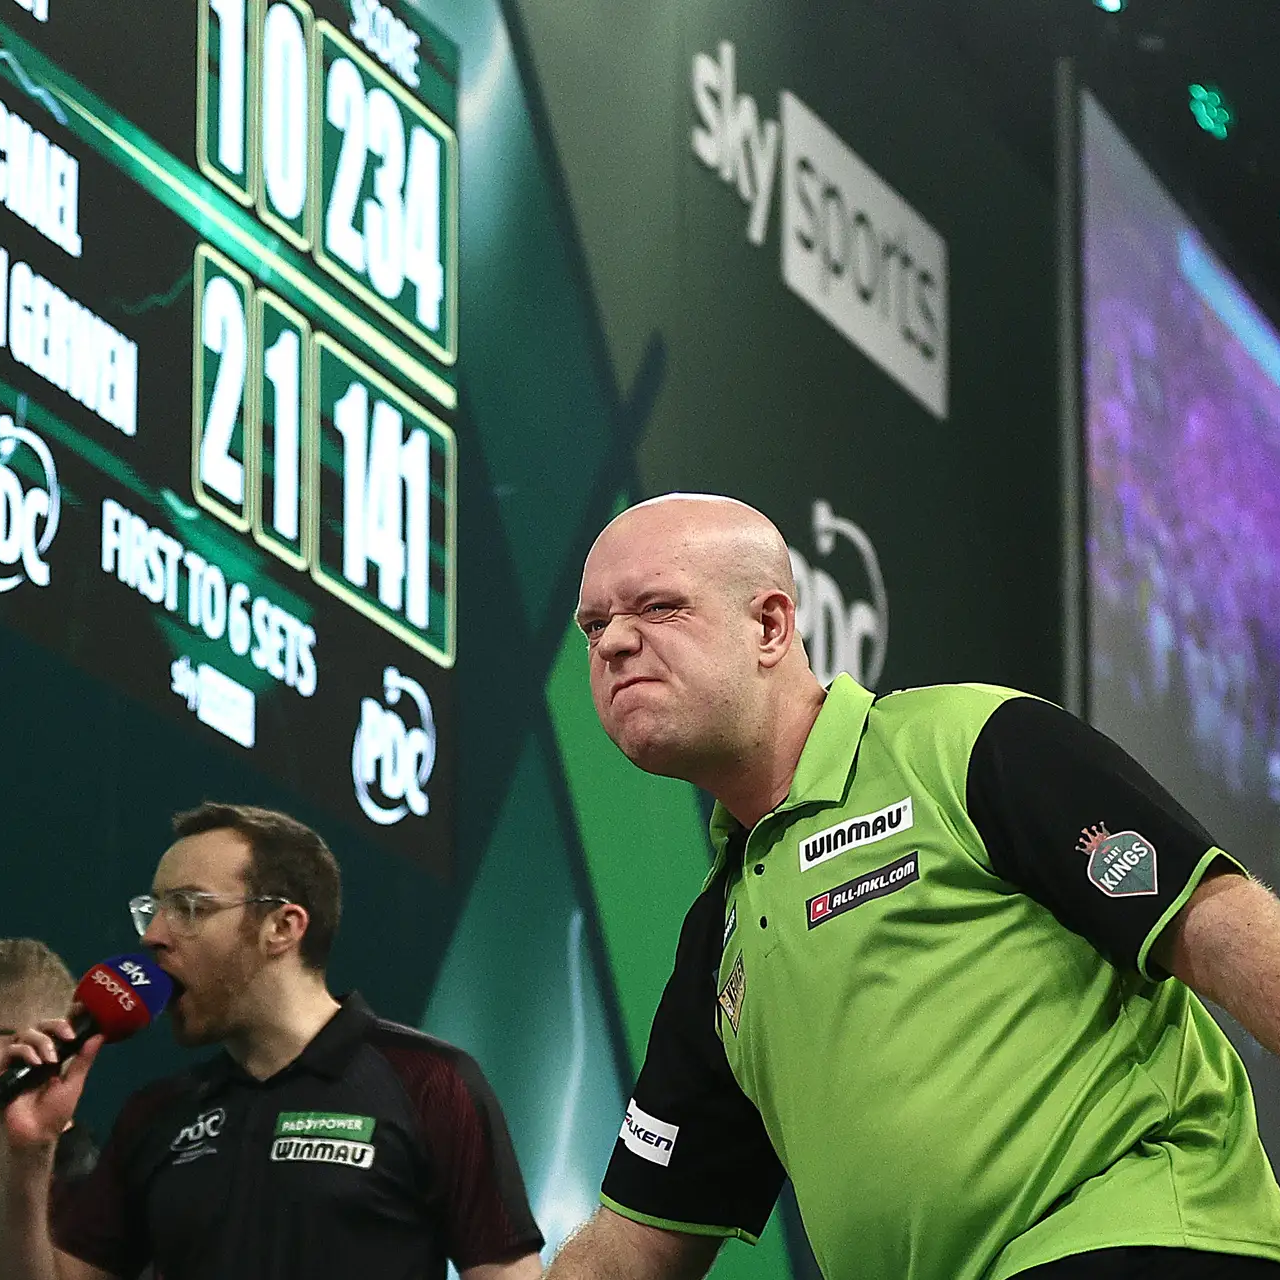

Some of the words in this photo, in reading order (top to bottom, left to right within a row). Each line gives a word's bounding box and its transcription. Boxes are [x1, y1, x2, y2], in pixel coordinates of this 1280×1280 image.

[326, 58, 444, 332] 234
[692, 39, 780, 246] sky
[793, 154, 938, 363] sports
[9, 261, 138, 437] GERWEN
[201, 276, 248, 504] 2
[334, 382, 430, 628] 141
[100, 498, 184, 612] FIRST
[183, 550, 228, 640] TO
[228, 581, 251, 656] 6
[250, 596, 318, 698] SETS
[358, 696, 431, 817] PDC
[804, 807, 902, 862] WINMAU
[1103, 846, 1122, 865] DART
[832, 860, 915, 908] ALL-INKL.COM
[1099, 842, 1148, 892] KINGS
[91, 970, 136, 1011] sports
[118, 960, 151, 986] sky
[281, 1118, 364, 1132] PADDYPOWER
[275, 1142, 369, 1165] WINMAU
